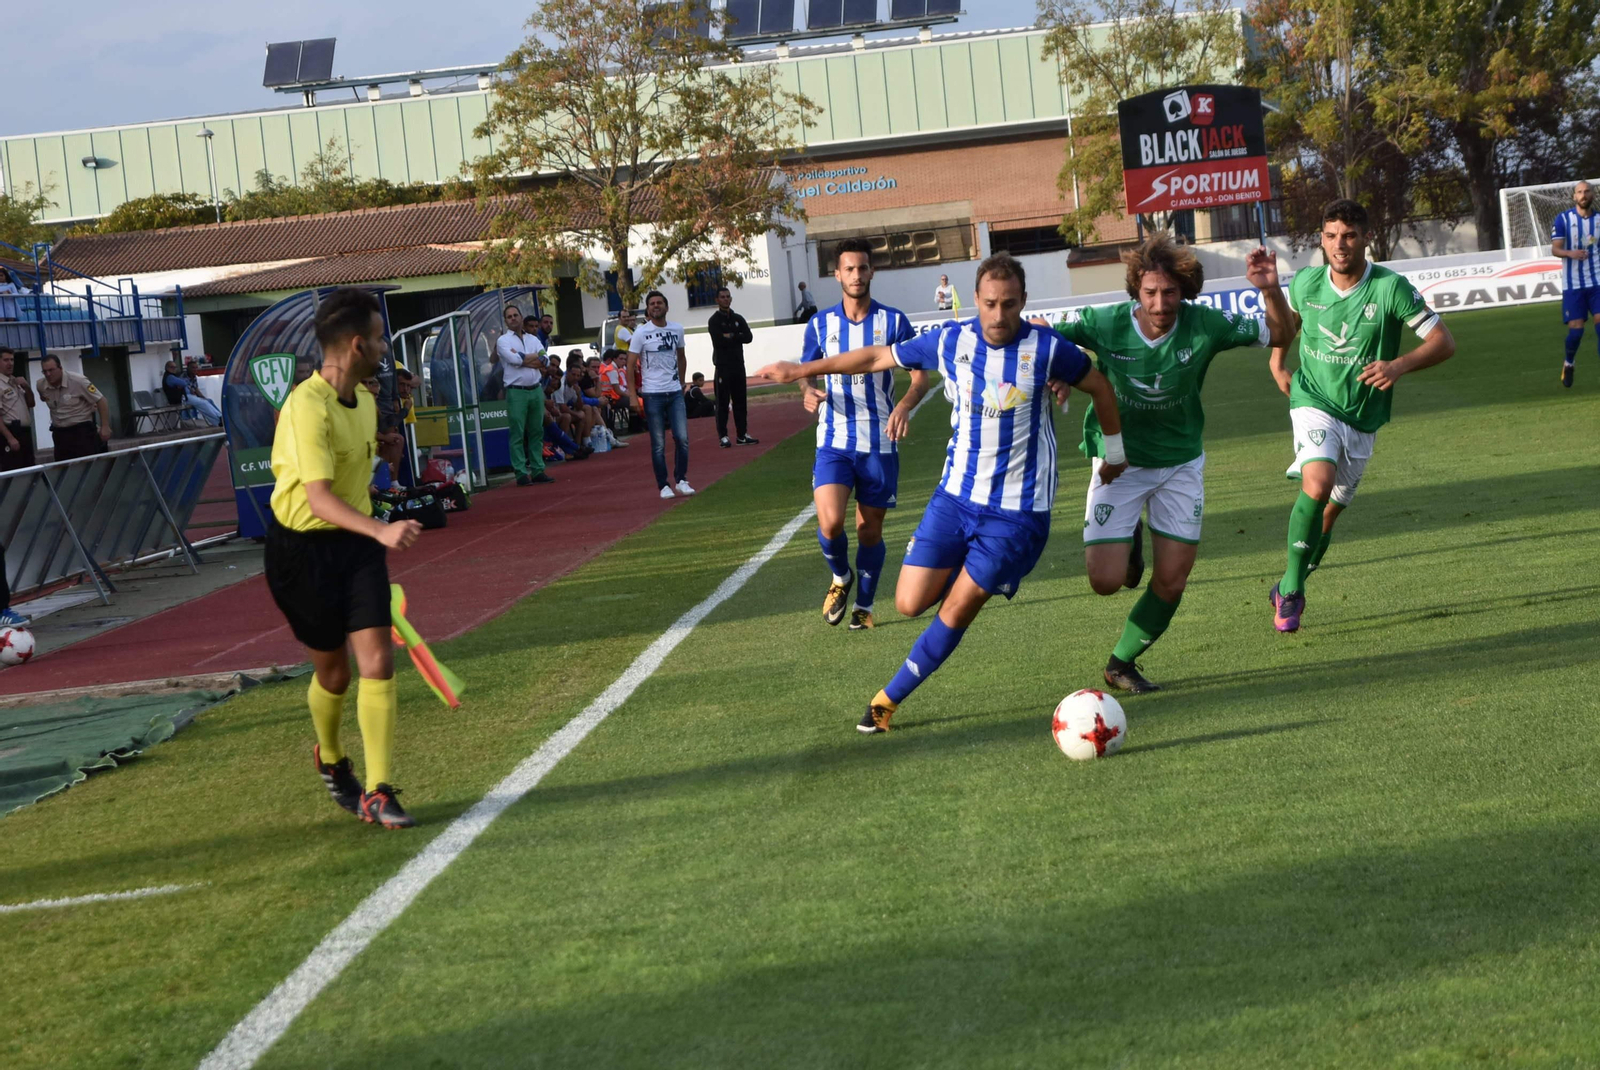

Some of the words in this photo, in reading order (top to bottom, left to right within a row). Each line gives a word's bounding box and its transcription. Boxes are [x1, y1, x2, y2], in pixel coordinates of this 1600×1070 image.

[1198, 97, 1212, 113] K
[798, 166, 867, 180] Polideportivo
[825, 176, 897, 195] Calderón
[1136, 168, 1260, 207] SPORTIUM
[1218, 193, 1234, 202] DON
[1235, 190, 1261, 200] BENITO
[1418, 271, 1441, 281] 630
[1445, 269, 1467, 278] 685
[1472, 266, 1494, 275] 345
[1433, 282, 1563, 309] BANA
[258, 358, 290, 385] CFV
[241, 462, 256, 471] C.F.
[258, 460, 272, 470] VIL
